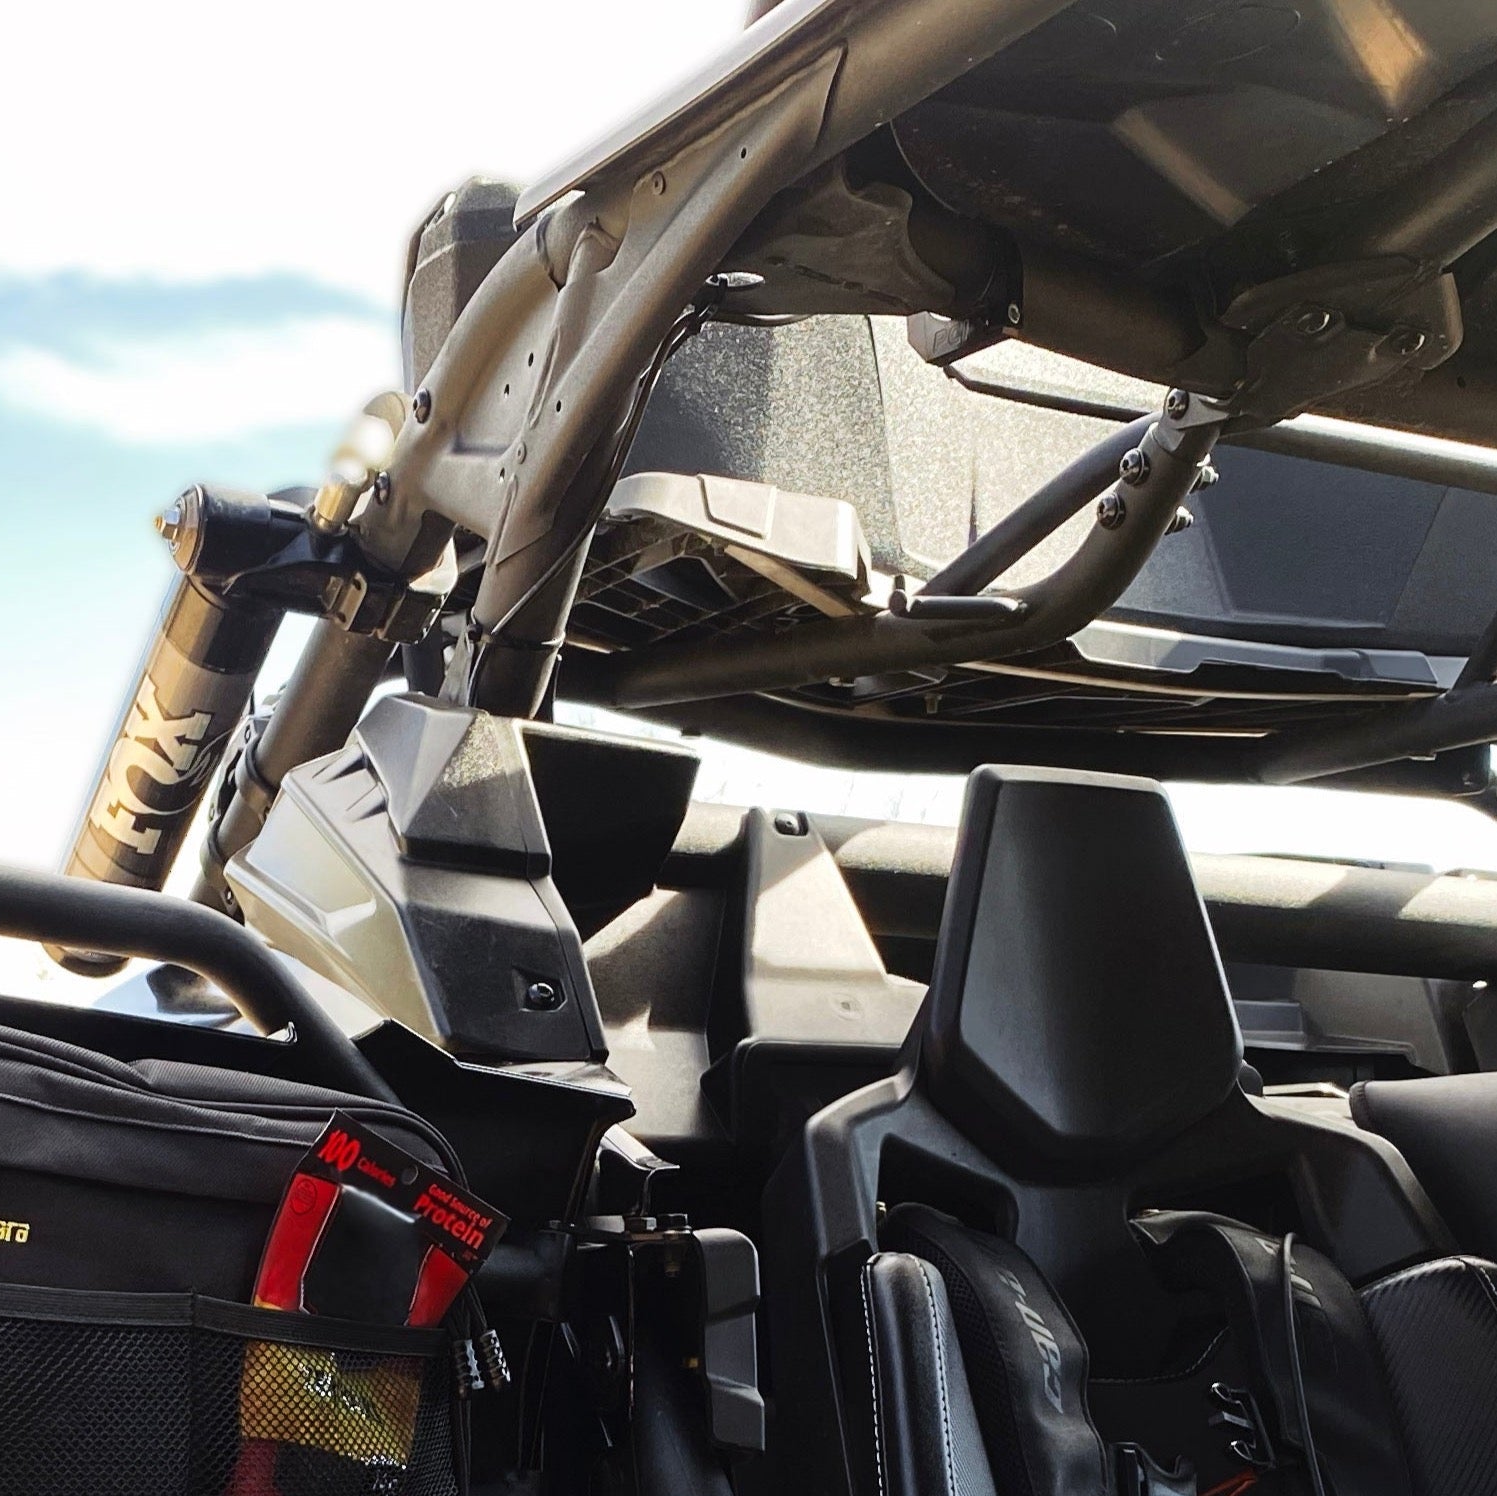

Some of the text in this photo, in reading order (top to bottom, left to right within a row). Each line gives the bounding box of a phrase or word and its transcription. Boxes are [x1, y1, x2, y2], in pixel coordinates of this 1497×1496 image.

[90, 671, 212, 856] FOX
[316, 1128, 361, 1172] 100
[413, 1193, 485, 1249] Protein
[428, 1183, 492, 1229] Good Source of
